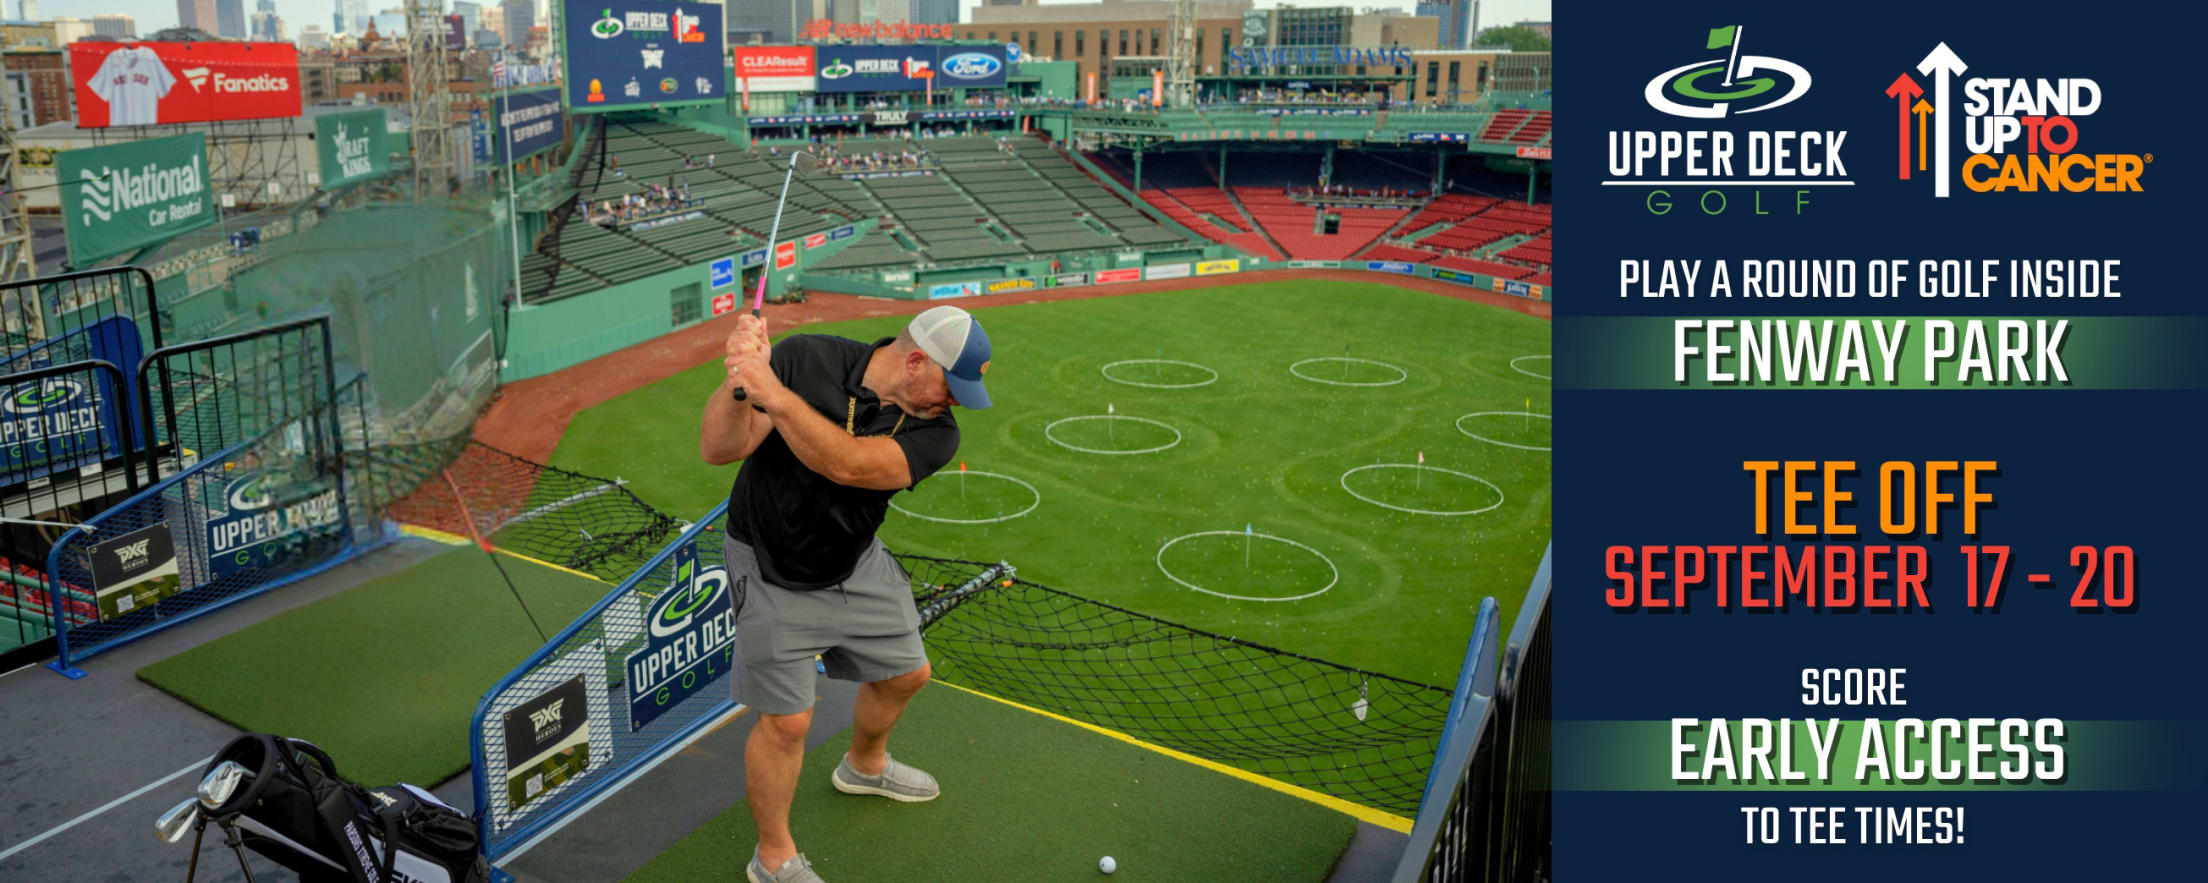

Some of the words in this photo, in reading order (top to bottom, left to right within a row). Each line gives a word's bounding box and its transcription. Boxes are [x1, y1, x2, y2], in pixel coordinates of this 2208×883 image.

[836, 23, 874, 38] new
[875, 19, 952, 38] balance
[953, 58, 992, 75] Ford
[1229, 46, 1317, 70] SAMUEL
[1329, 44, 1412, 68] ADAMS
[213, 73, 288, 93] Fanatics
[874, 112, 908, 122] TRULY
[112, 154, 200, 213] National
[149, 208, 167, 226] Car
[169, 197, 202, 221] Rental
[213, 508, 280, 551] UPPER
[114, 538, 150, 564] PXG
[634, 631, 697, 694] UPPER
[656, 644, 732, 706] GOLF
[529, 698, 564, 733] PXG
